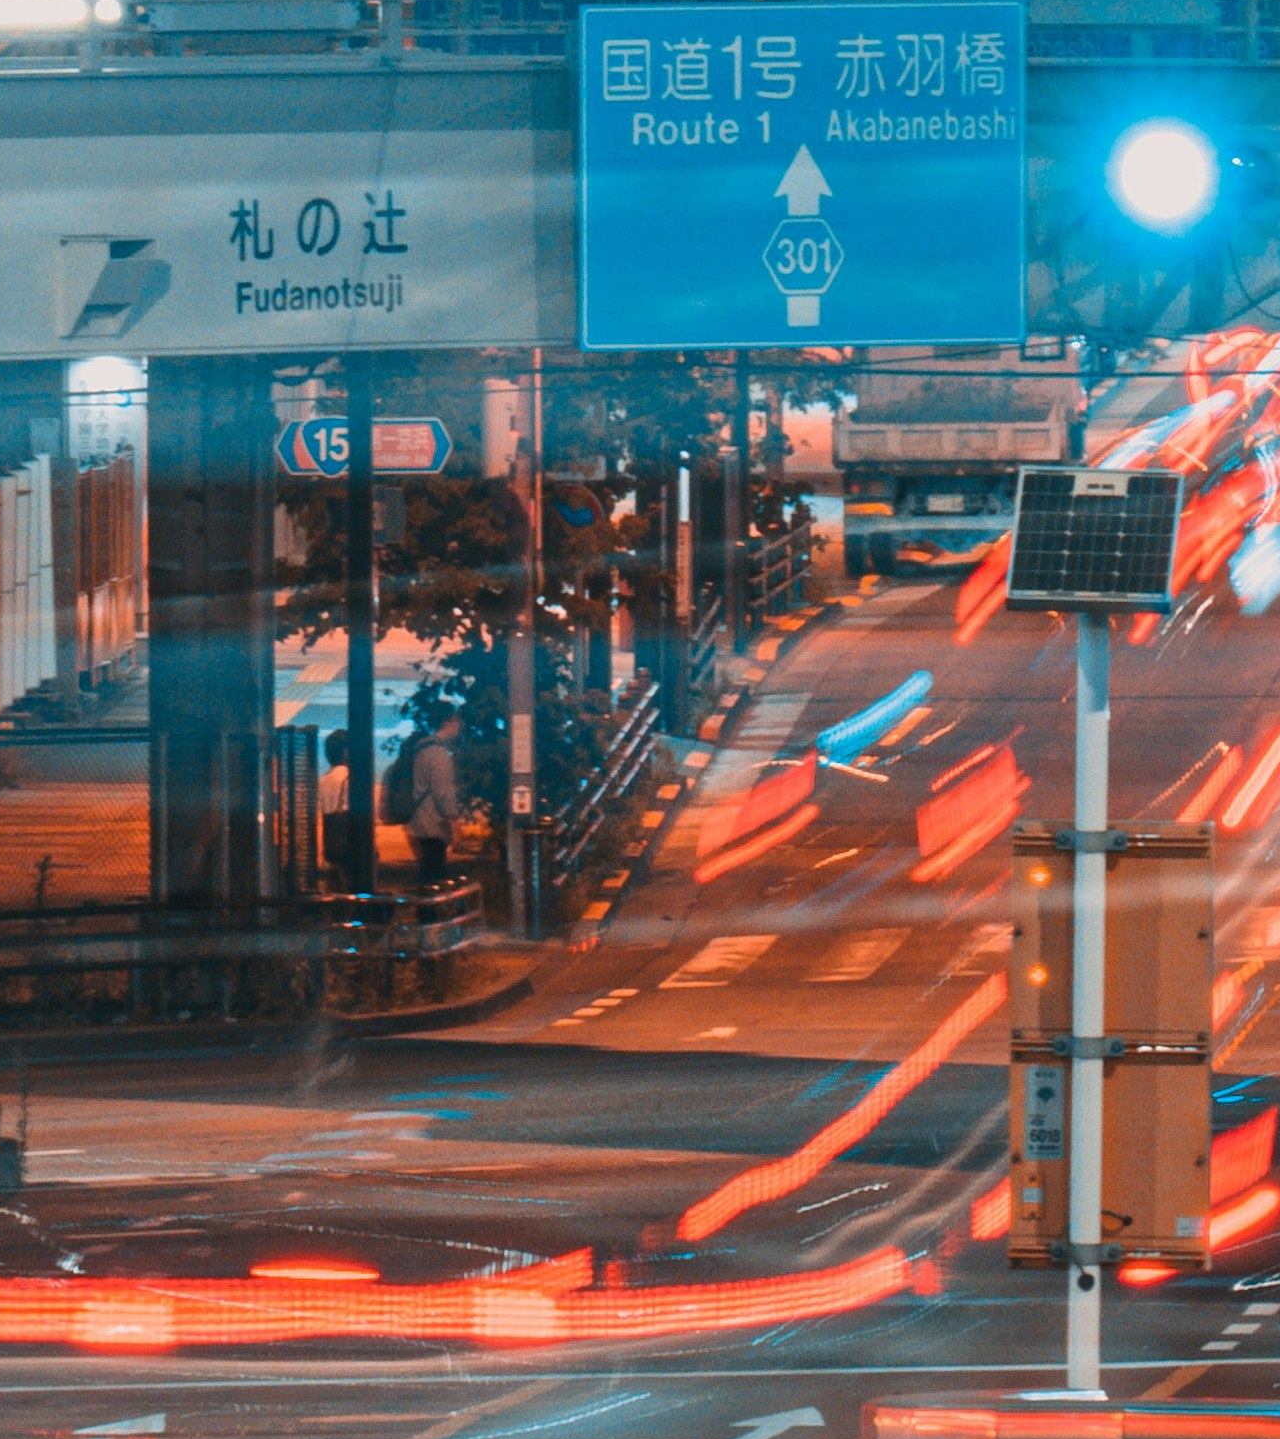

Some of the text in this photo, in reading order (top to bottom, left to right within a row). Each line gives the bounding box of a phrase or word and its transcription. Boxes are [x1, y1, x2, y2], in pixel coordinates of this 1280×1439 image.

[602, 34, 802, 102] 国道1号
[835, 32, 1007, 99] 赤羽橋
[631, 105, 1018, 146] Route 1 Akabanebashi
[229, 189, 410, 262] 札の辻
[776, 237, 834, 275] 301
[235, 272, 404, 315] Fudanotsuji
[313, 427, 351, 463] 15
